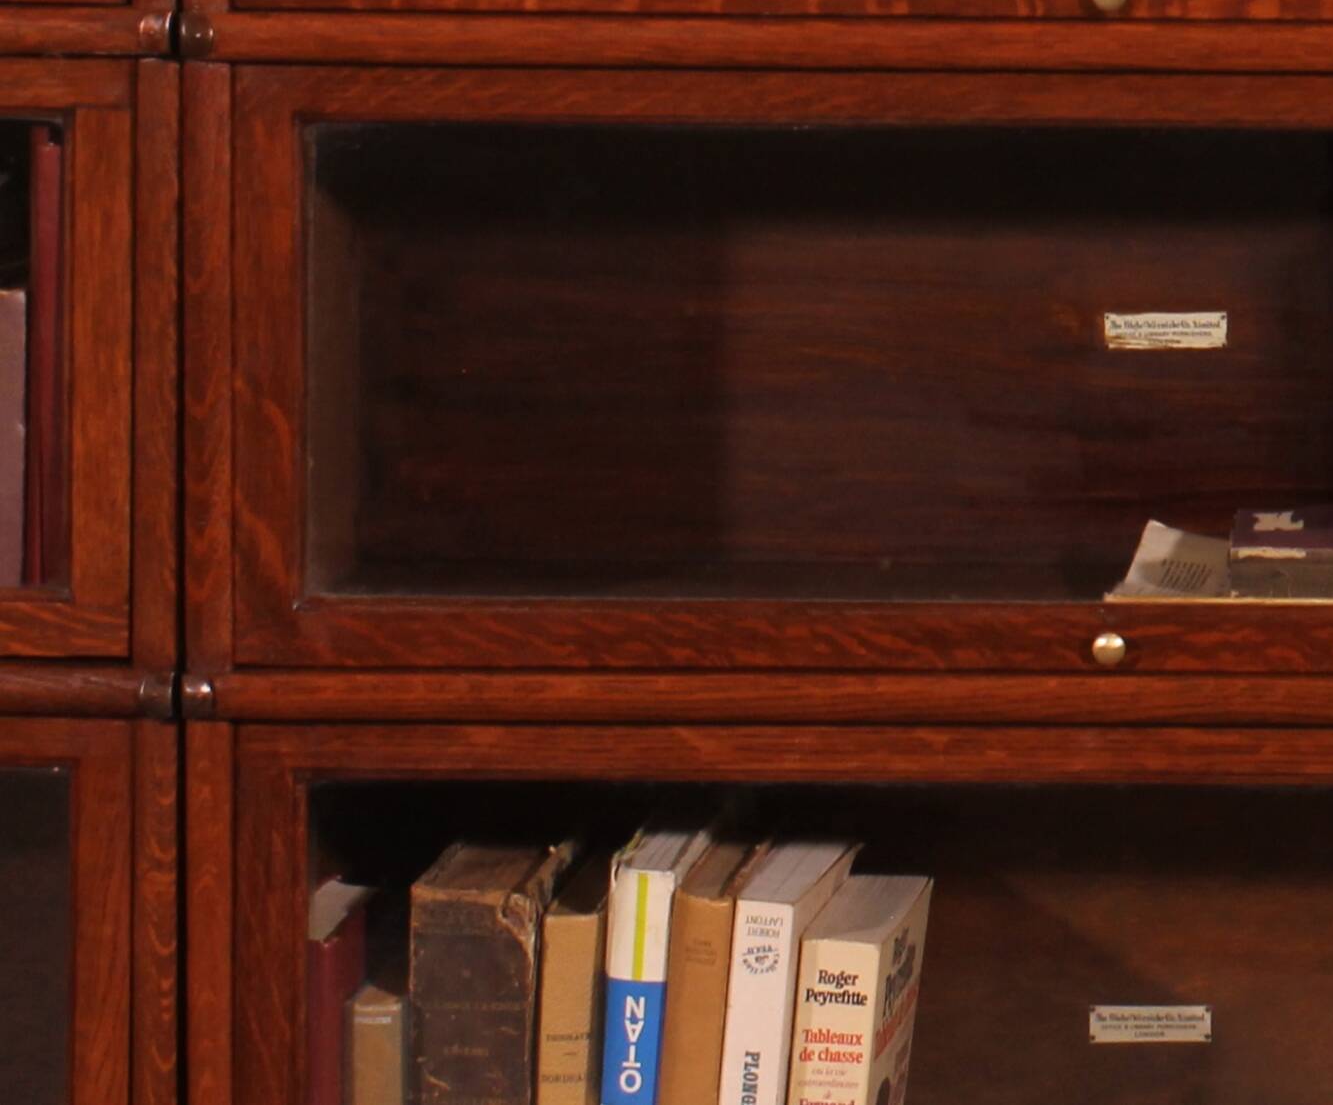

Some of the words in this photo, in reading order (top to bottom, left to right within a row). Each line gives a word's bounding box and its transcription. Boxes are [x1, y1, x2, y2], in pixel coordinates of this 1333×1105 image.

[817, 968, 860, 989] Roger
[805, 986, 869, 1007] Peyrefitte
[802, 1028, 864, 1046] Tableaux
[799, 1046, 816, 1063] de
[817, 1047, 864, 1064] chasse
